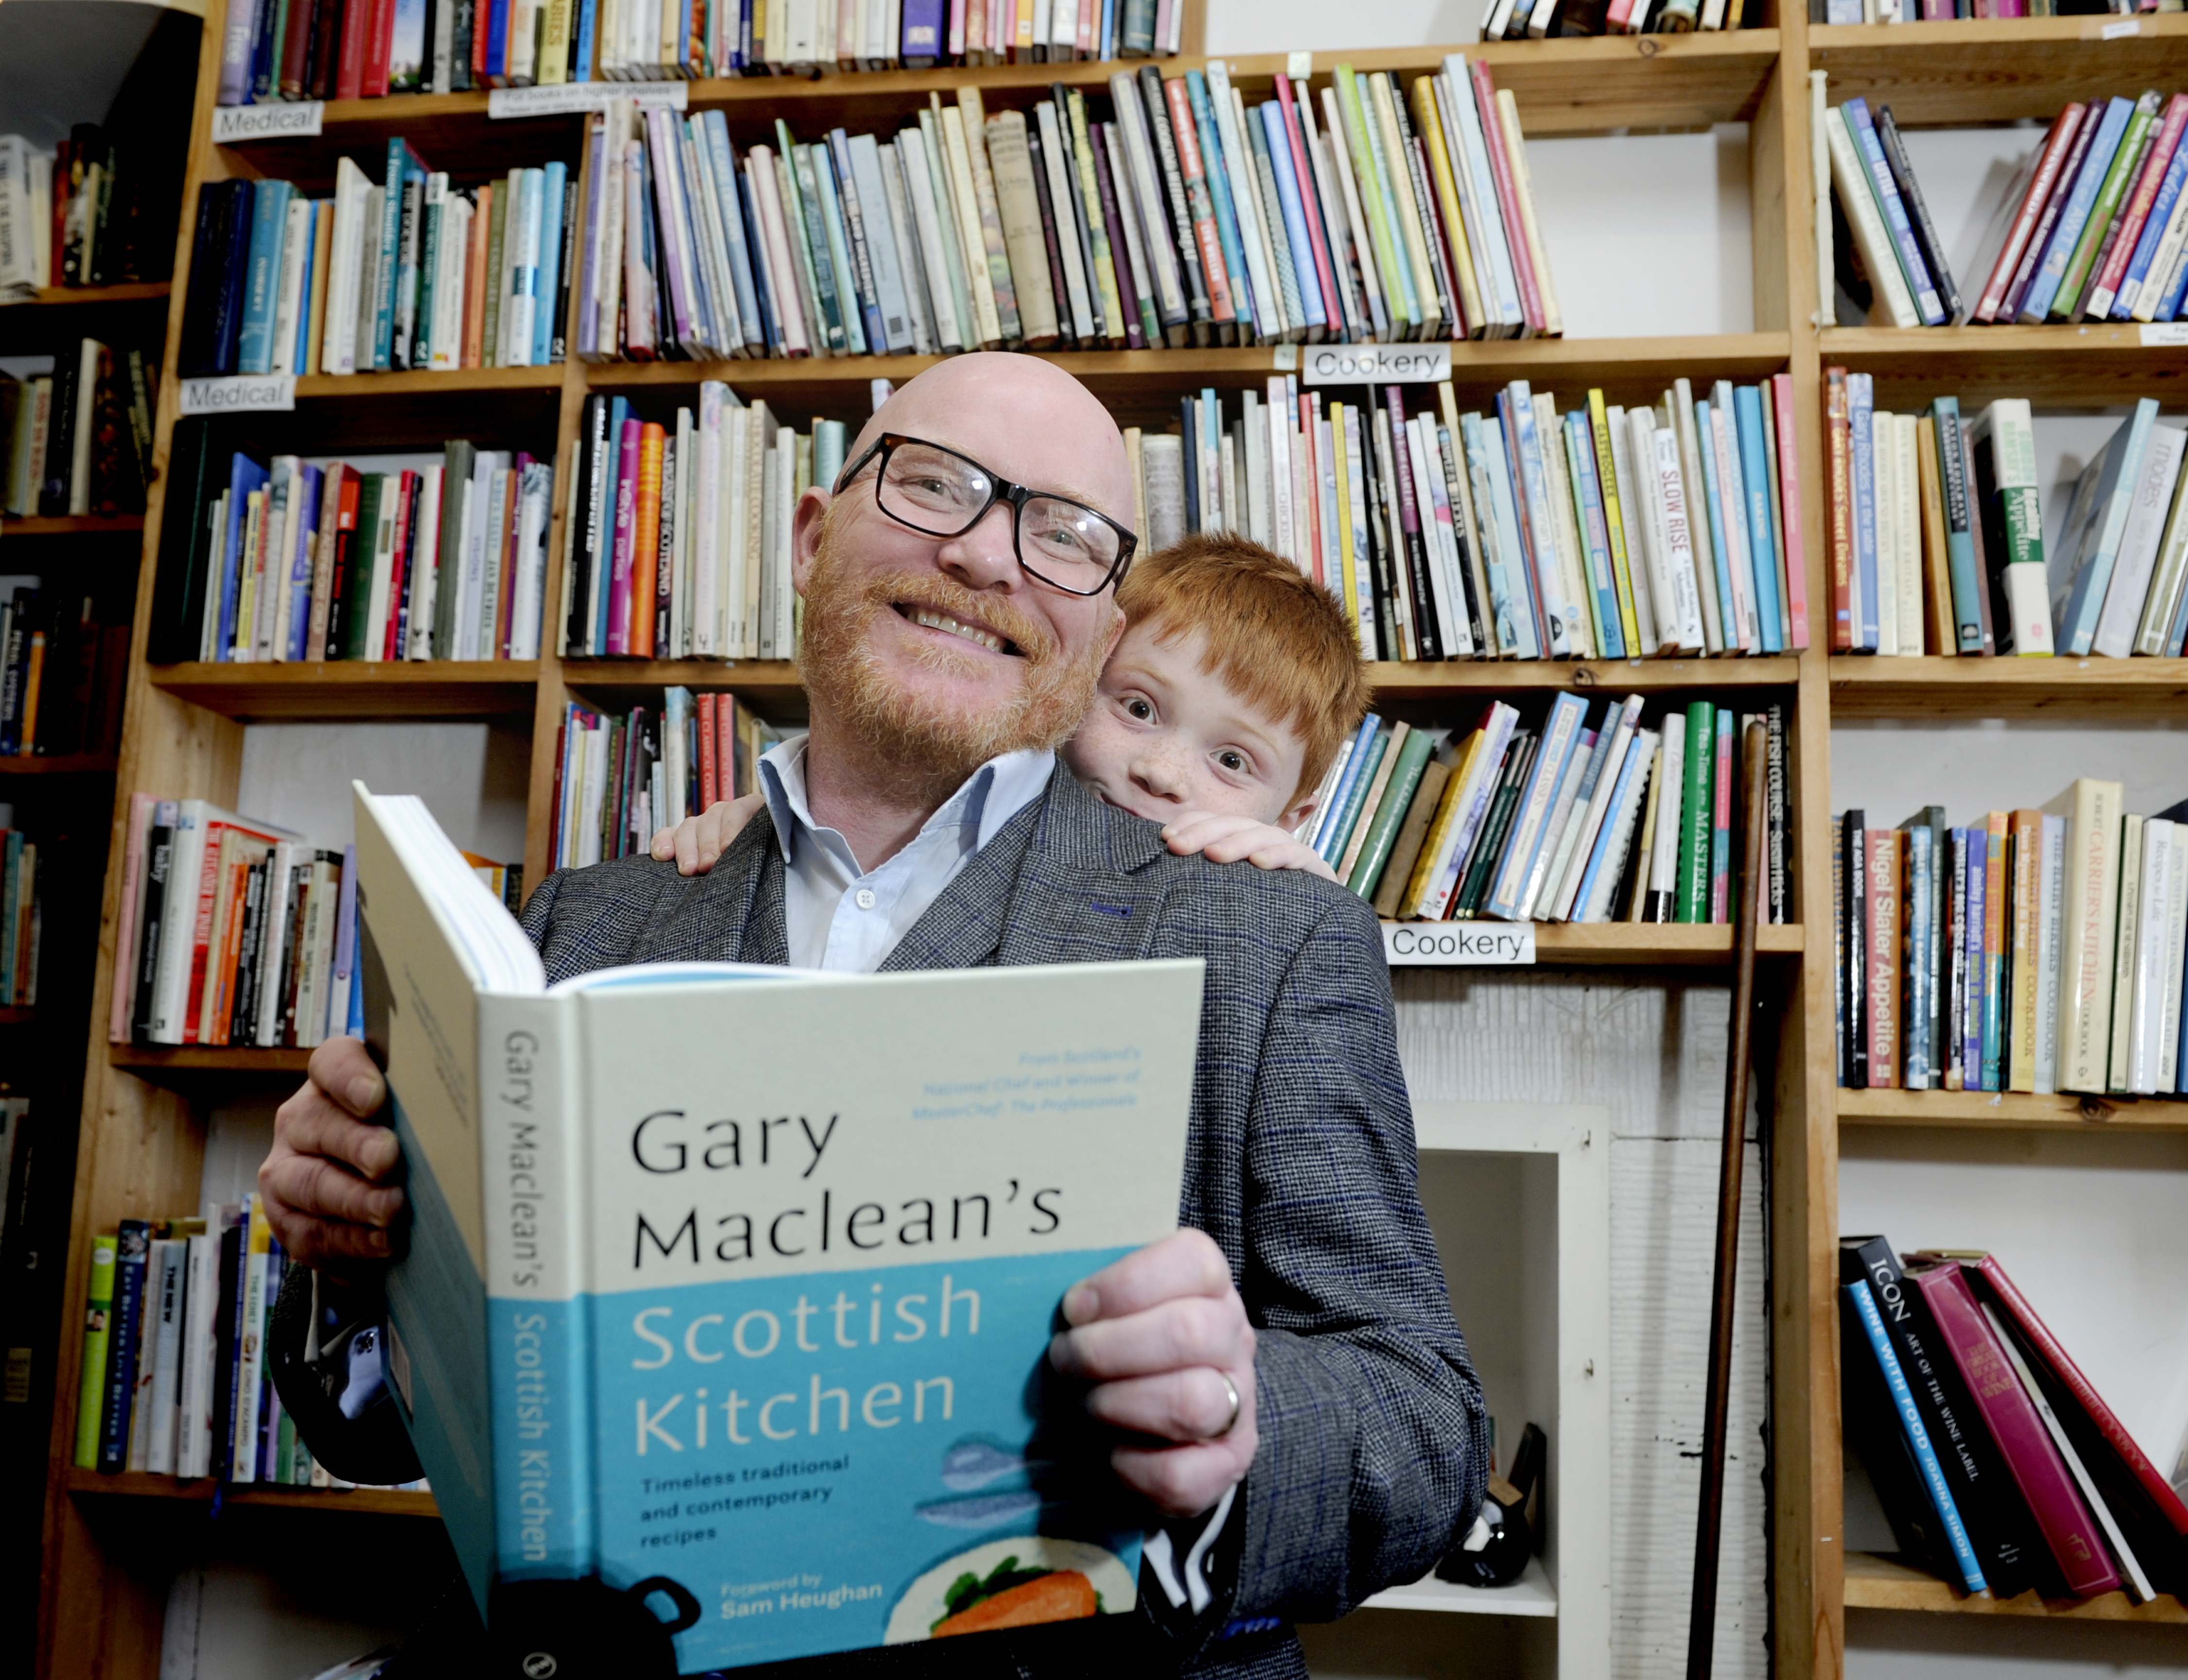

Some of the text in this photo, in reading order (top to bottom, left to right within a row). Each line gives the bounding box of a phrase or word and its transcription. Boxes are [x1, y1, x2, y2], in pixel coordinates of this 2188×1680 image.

[529, 90, 560, 100] books
[584, 87, 619, 99] higher
[625, 86, 670, 96] shelves
[219, 108, 315, 134] Medical
[383, 198, 398, 250] Shoulder
[1315, 351, 1441, 380] Cookery
[188, 382, 285, 407] Medical
[1853, 409, 1875, 555] Gary Rhodes at the table
[2141, 442, 2172, 509] rhodes
[1661, 469, 1692, 555] SLOW RISE
[2007, 491, 2032, 562] Appetite
[656, 522, 672, 595] SCOTLAND
[1766, 704, 1782, 734] THE
[1767, 735, 1782, 767] FISH
[1533, 761, 1555, 808] CLASSICS
[1768, 767, 1784, 822] COURSE
[1692, 725, 1711, 902] Tea-Time MASTERS
[2092, 792, 2103, 829] ROBERT
[1770, 829, 1783, 868] Susan
[2020, 824, 2030, 851] Dave
[2173, 845, 2185, 872] JOHN
[1852, 828, 1864, 898] THE AGA BOOK
[1955, 837, 1966, 891] AINSLEY'S
[1969, 865, 1983, 902] ainsley
[2019, 852, 2029, 886] Myers
[2029, 859, 2039, 905] HAIRY
[2152, 840, 2167, 884] Recipes
[1955, 892, 1966, 915] BIG
[2018, 887, 2028, 907] and
[1392, 929, 1525, 961] Cookery
[1871, 838, 1894, 1056] Nigel Slater Appetite
[1954, 915, 1965, 947] COOK
[1970, 903, 1983, 951] harriott's
[2045, 834, 2063, 1063] THE HAIRY COOKBOOK
[1954, 947, 1965, 972] OUT
[1970, 953, 1981, 983] meals
[2081, 920, 2100, 1000] KITCHEN
[2167, 916, 2180, 987] ENTERTAINING
[1968, 998, 1980, 1039] minutes
[2025, 974, 2036, 1057] COOKBOOK
[2079, 1000, 2093, 1058] COOKBOOK
[1019, 1046, 1141, 1067] From Scotland's
[923, 1068, 1140, 1097] National Chef and Winner of
[1009, 1098, 1037, 1114] The
[1040, 1092, 1137, 1119] Professionals
[631, 1109, 840, 1179] Gary
[634, 1178, 1063, 1270] Maclean's
[165, 1266, 176, 1290] THE
[500, 1029, 554, 1562] Gary Maclean's Scottish Kitchen
[1868, 1256, 1912, 1325] ICON
[162, 1292, 174, 1323] NEW
[631, 1274, 982, 1370] Scottish
[1857, 1287, 1930, 1452] WINE WITH FOOD
[635, 1373, 955, 1456] Kitchen
[1904, 1330, 1980, 1482] ART OF THE WINE LABEL
[2093, 1405, 2150, 1475] COOKBOOK
[641, 1455, 850, 1495] Timeless traditional
[640, 1484, 832, 1523] and contemporary
[1923, 1455, 1970, 1559] JOANNA SIMON
[640, 1524, 717, 1549] recipes
[720, 1572, 823, 1598] Foreword by
[720, 1582, 883, 1620] Sam Heughan
